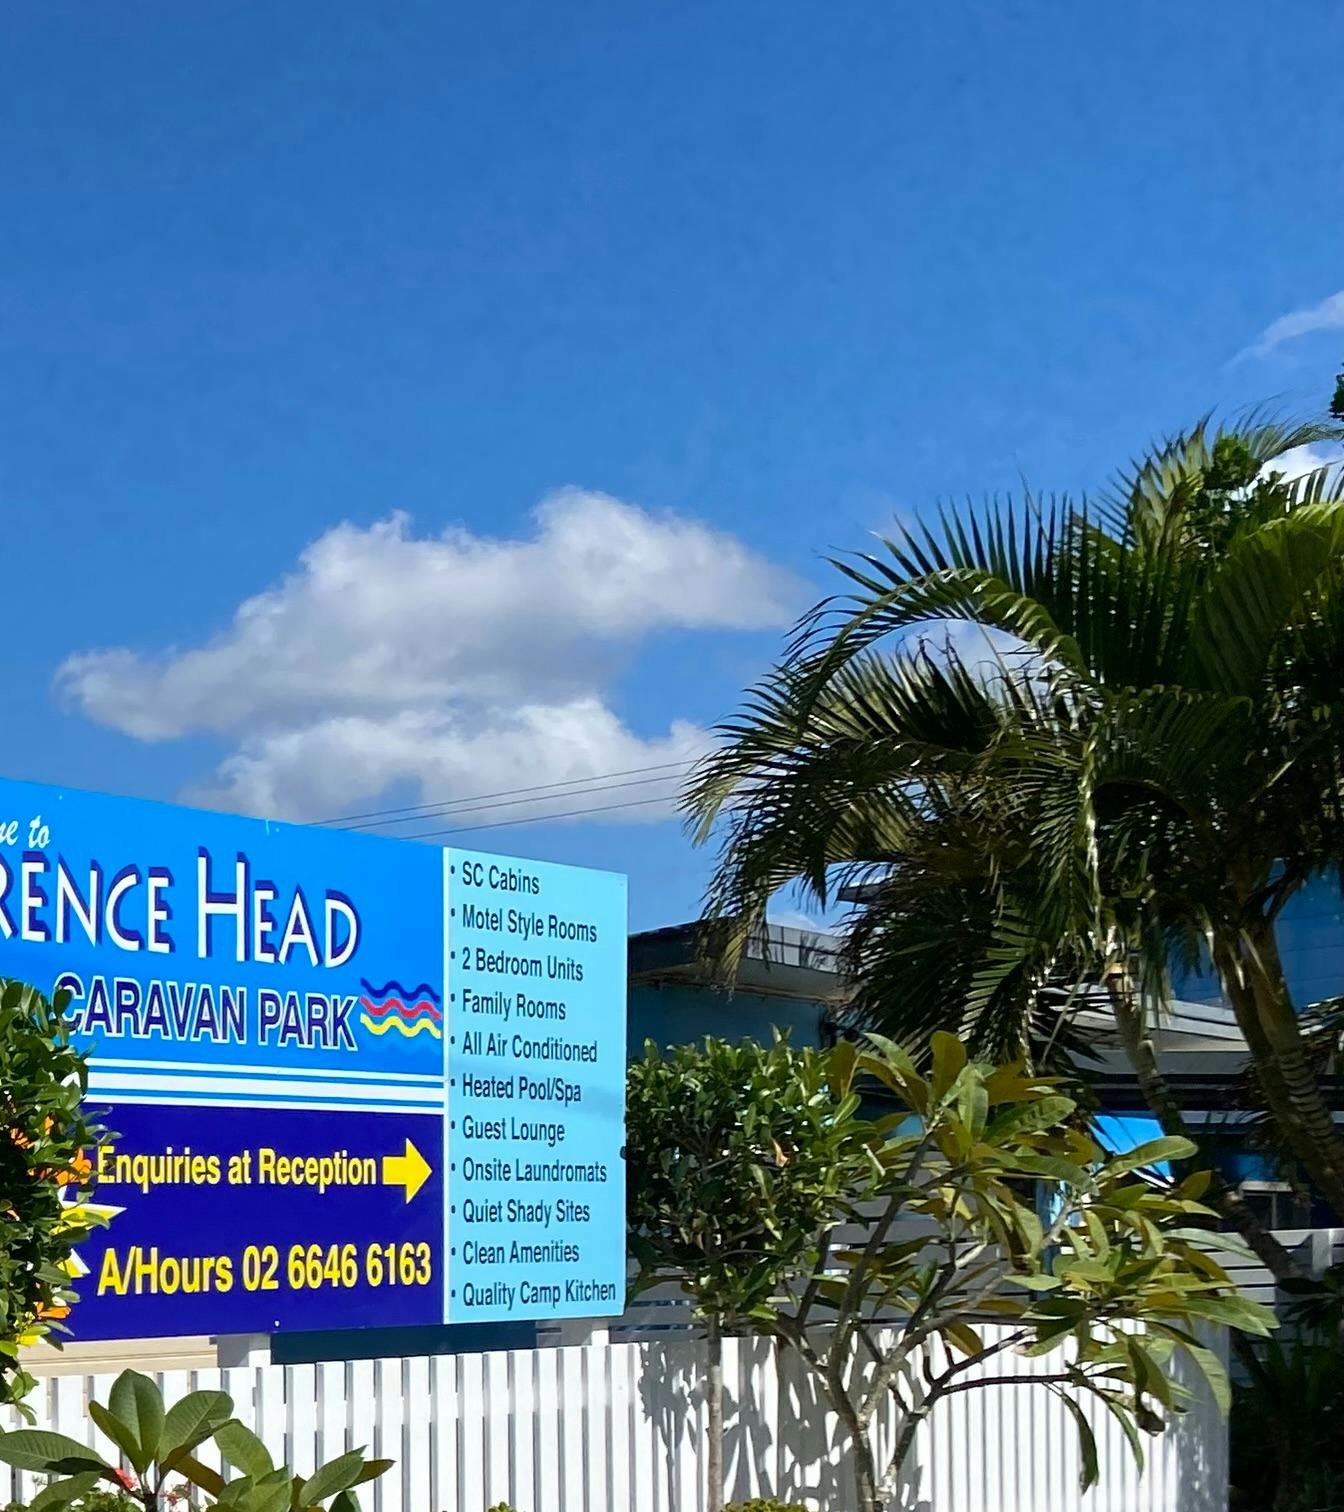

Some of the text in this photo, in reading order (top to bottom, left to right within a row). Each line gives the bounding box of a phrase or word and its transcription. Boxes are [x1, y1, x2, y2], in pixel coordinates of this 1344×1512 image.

[28, 815, 51, 849] to
[462, 861, 540, 895] SC Cabins
[197, 846, 361, 968] HEAD
[463, 904, 597, 943] Motel Style Rooms
[462, 947, 584, 981] 2 Bedroom Units
[52, 971, 359, 1051] CARAVAN PARK
[463, 989, 566, 1022] Family Rooms
[463, 1031, 597, 1063] All Air Conditioned
[463, 1073, 581, 1107] Heated Pool/Spa
[463, 1115, 565, 1147] Guest Lounge
[97, 1146, 377, 1194] Enquiries at Reception
[463, 1157, 607, 1182] Onsite Laundromats
[463, 1199, 590, 1228] Quiet Shady Sites
[97, 1241, 432, 1296] A/Hours 02 6646 6163
[463, 1240, 579, 1264] Clean Amenities
[463, 1279, 616, 1310] Quality Camp Kitchen
